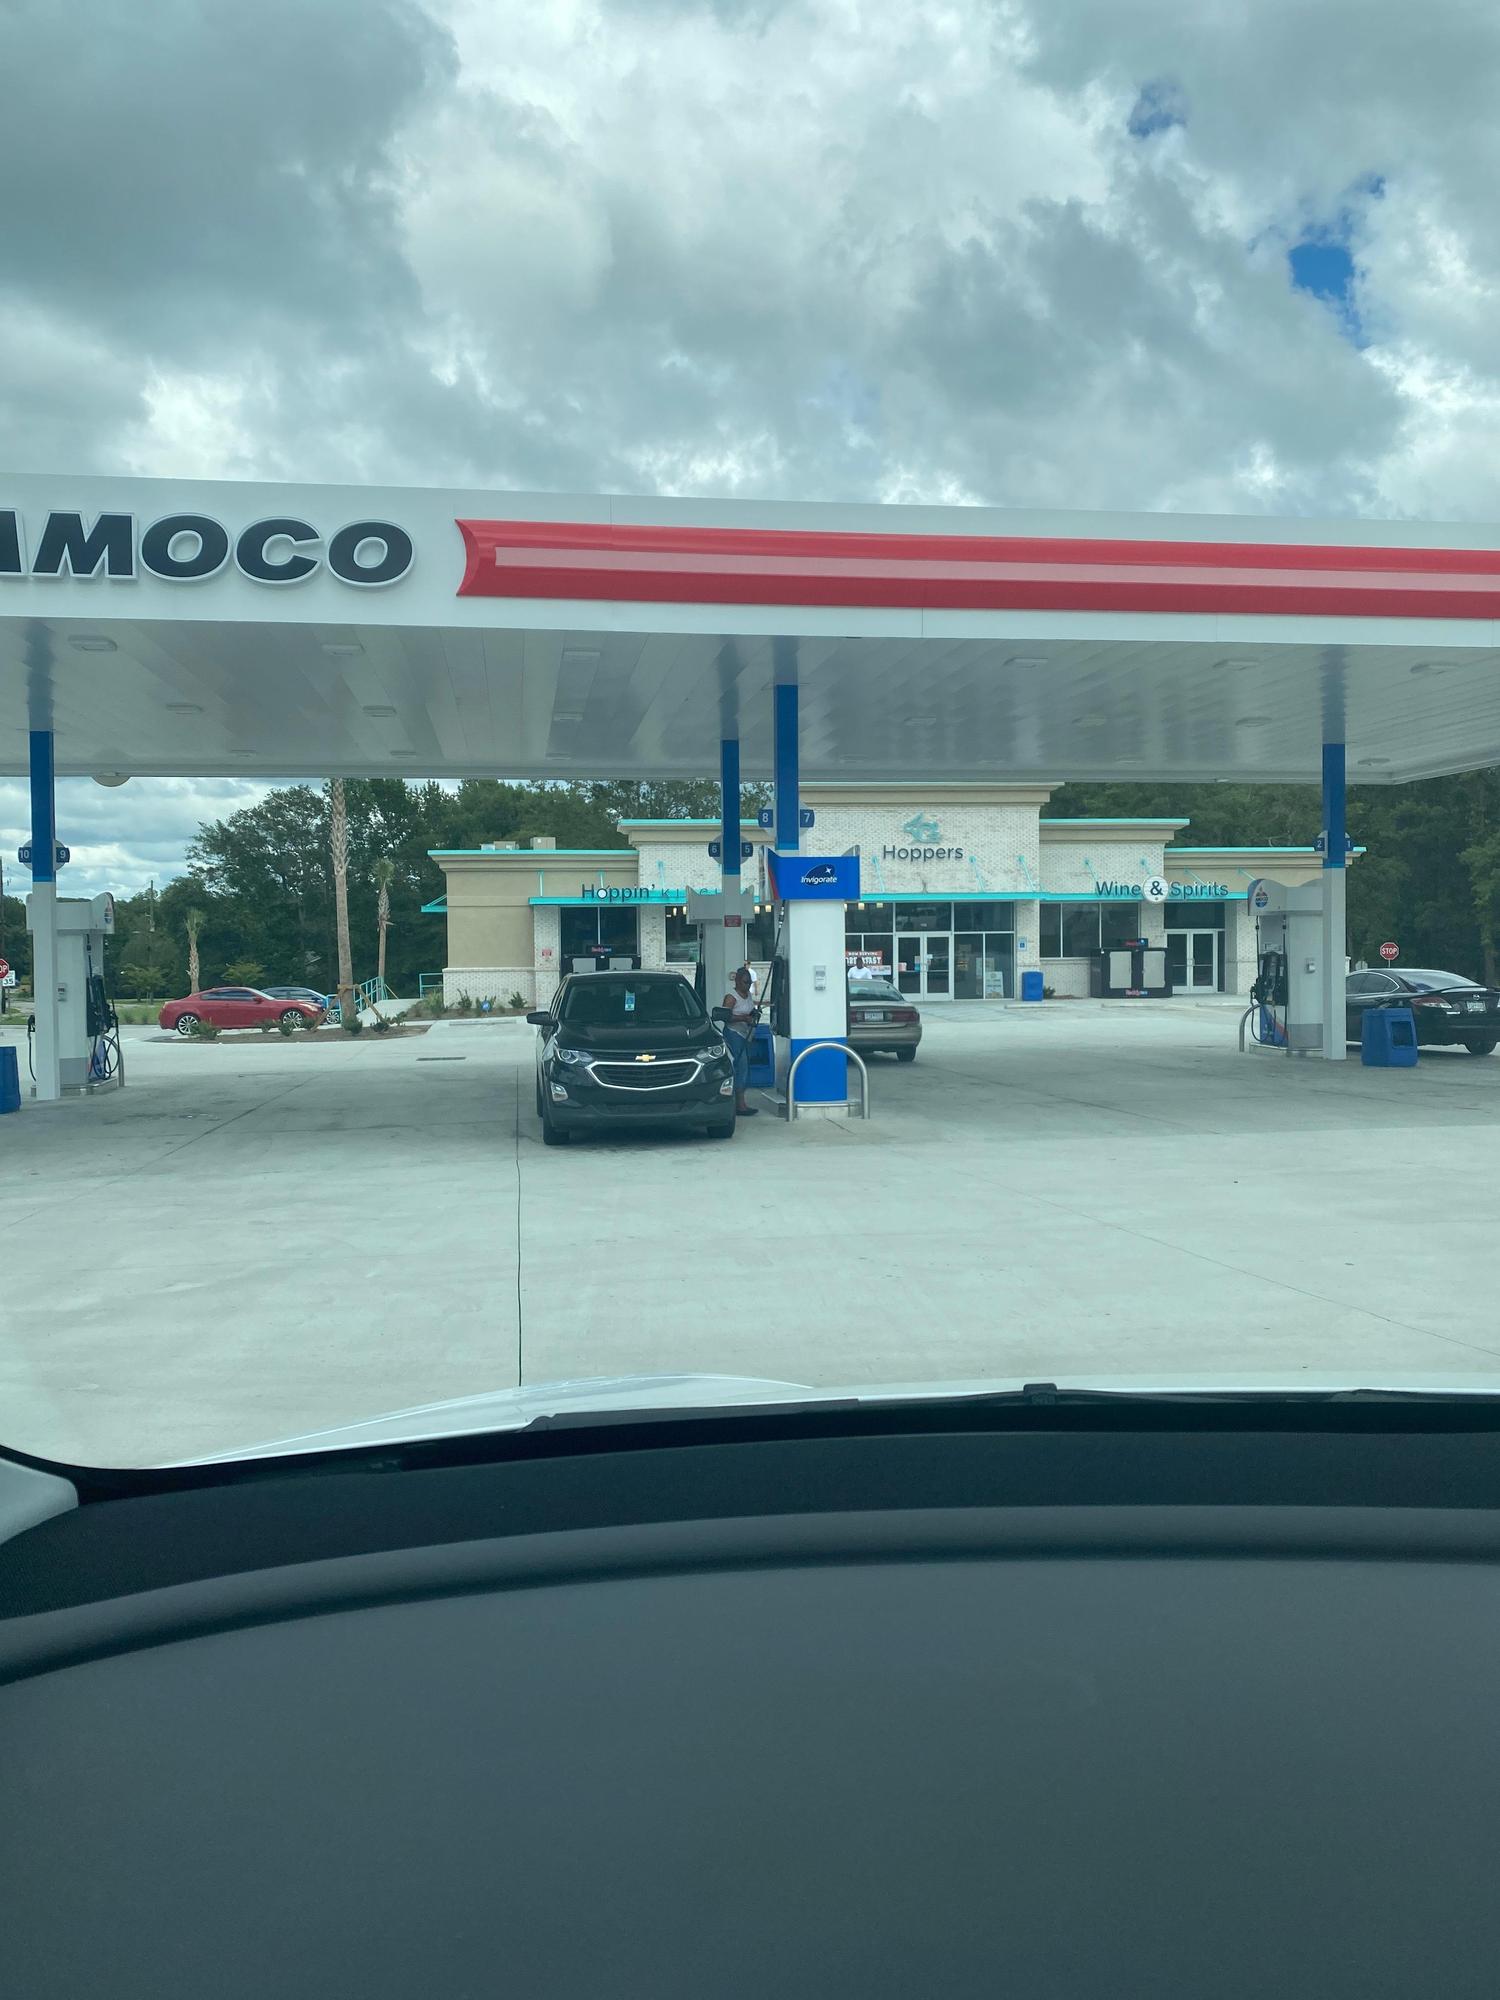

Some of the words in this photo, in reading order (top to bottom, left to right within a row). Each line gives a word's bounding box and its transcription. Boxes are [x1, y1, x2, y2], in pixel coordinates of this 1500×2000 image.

[0, 509, 416, 587] MOCO
[762, 813, 769, 823] 8
[804, 813, 811, 823] 7
[1317, 840, 1323, 848] 2
[19, 849, 30, 859] 10
[60, 849, 66, 859] 9
[711, 845, 718, 854] 6
[744, 845, 750, 854] 5
[883, 844, 964, 862] Hoppers
[800, 874, 838, 886] Invigorate
[1095, 880, 1141, 896] Wine
[1150, 880, 1164, 896] &
[1170, 881, 1229, 899] Spirits
[1381, 947, 1398, 955] STOP
